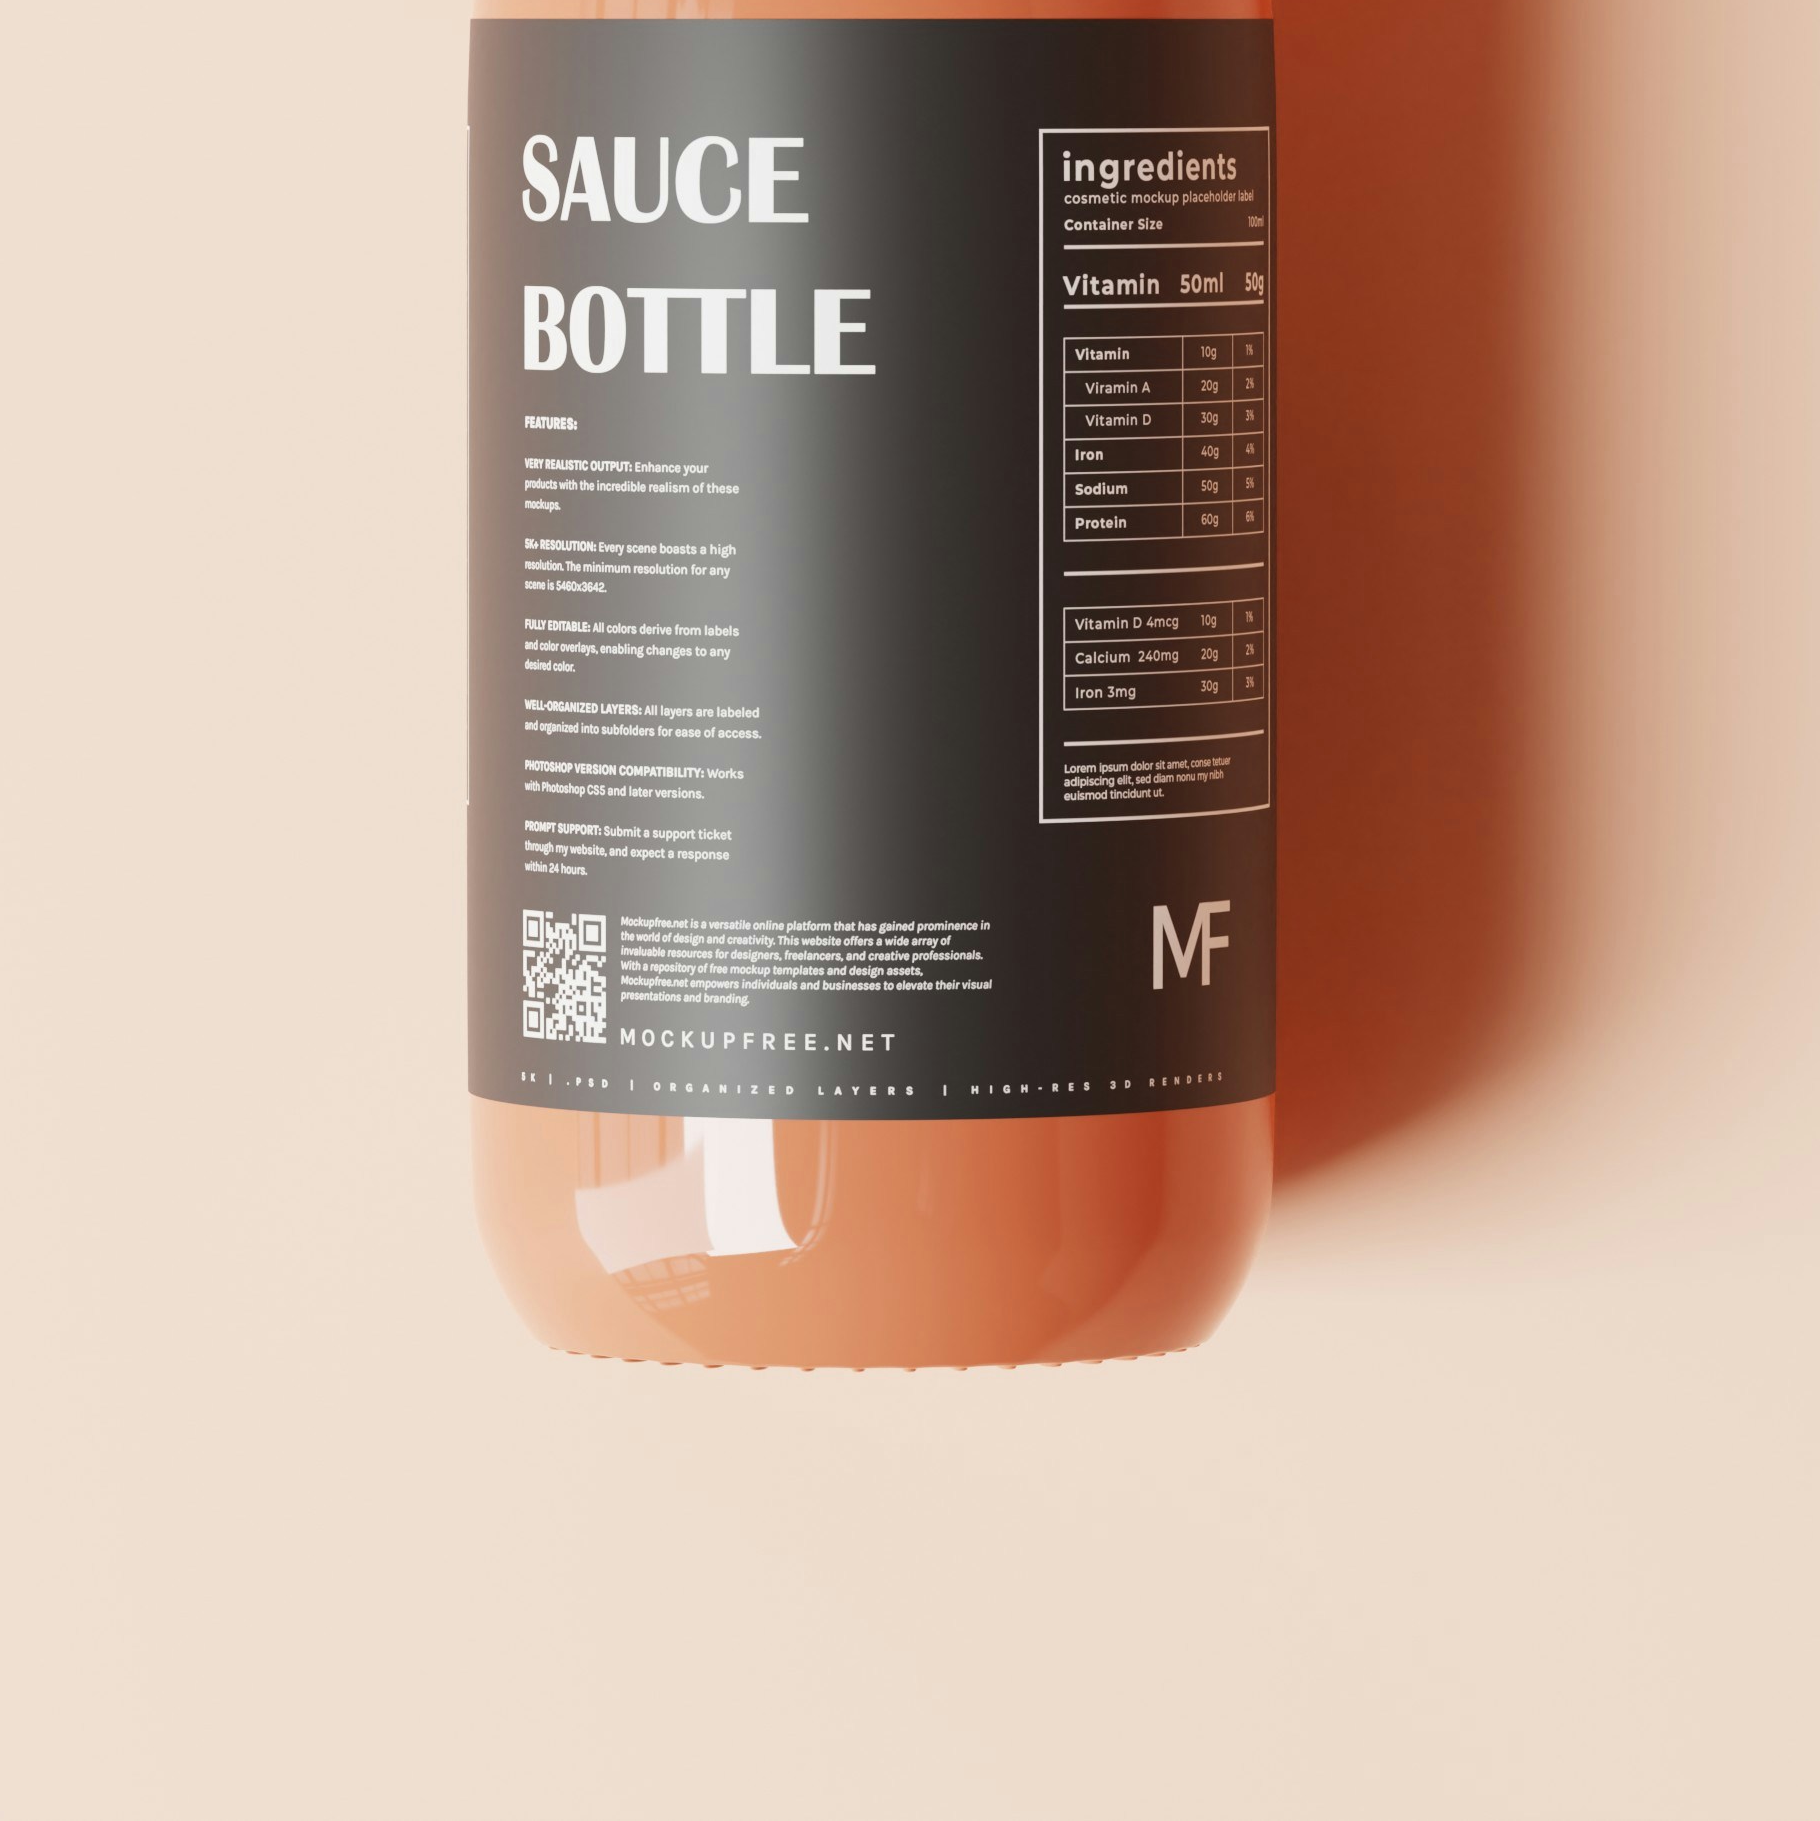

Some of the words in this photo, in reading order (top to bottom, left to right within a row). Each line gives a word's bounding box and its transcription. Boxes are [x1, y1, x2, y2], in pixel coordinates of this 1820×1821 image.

[1062, 149, 1237, 190] ingredients
[522, 134, 809, 224] SAUCE
[1064, 191, 1127, 205] cosmetic
[1131, 191, 1180, 206] mockup
[1182, 190, 1236, 206] placeholder
[1238, 189, 1254, 202] label
[1064, 217, 1134, 231] Container
[1137, 217, 1163, 231] Size
[1062, 272, 1160, 296] Vitamin
[1180, 271, 1224, 294] 50ml
[1245, 271, 1264, 296] 50g
[524, 285, 876, 375] BOTTLE
[1074, 347, 1130, 361] Vitamin
[1200, 345, 1217, 361] 10g
[1085, 381, 1138, 395] Viramin
[1141, 381, 1151, 393] A
[1201, 379, 1219, 394] 20g
[524, 415, 578, 431] FEATURES:
[1085, 413, 1138, 427] Vitamin
[1142, 413, 1152, 426] D
[1200, 411, 1219, 426] 30g
[1075, 448, 1104, 461] Iron
[1200, 445, 1219, 460] 40g
[524, 457, 544, 469] VERY
[544, 458, 589, 471] REALISTIC
[590, 460, 633, 473] OUTPUT:
[634, 461, 682, 474] Enhance
[682, 464, 710, 477] your
[524, 477, 558, 491] products
[558, 479, 578, 491] with
[579, 479, 595, 491] the
[596, 479, 647, 493] incredible
[648, 481, 690, 494] realism
[692, 481, 705, 494] of
[706, 482, 740, 495] these
[1075, 481, 1128, 496] Sodium
[1201, 479, 1219, 494] 50g
[524, 498, 561, 513] mockups.
[1075, 515, 1127, 530] Protein
[1201, 513, 1219, 528] 60g
[524, 537, 540, 550] 5K+
[539, 538, 597, 552] RESOLUTION:
[598, 541, 625, 557] Every
[626, 544, 658, 554] scene
[659, 542, 698, 555] boasts
[699, 545, 707, 555] a
[709, 543, 737, 559] high
[524, 559, 565, 571] resolution.
[564, 560, 582, 573] The
[582, 561, 632, 574] minimum
[633, 563, 688, 575] resolution
[690, 563, 708, 576] for
[709, 566, 731, 579] any
[524, 580, 546, 591] scene
[547, 579, 555, 591] is
[556, 580, 608, 593] 5460x3642.
[524, 618, 547, 631] FULLY
[547, 619, 591, 633] EDITABLE:
[592, 621, 605, 633] All
[606, 622, 638, 635] colors
[639, 623, 672, 636] derive
[674, 623, 702, 636] from
[704, 624, 740, 637] labels
[1074, 616, 1129, 631] Vitamin
[1133, 616, 1142, 629] D
[1146, 616, 1179, 630] 4mcg
[1200, 614, 1217, 629] 10g
[1075, 651, 1131, 665] Calcium
[1138, 649, 1179, 664] 240mg
[1201, 647, 1218, 662] 20g
[524, 658, 552, 671] desired
[552, 660, 576, 673] color.
[1075, 687, 1103, 699] Iron
[1107, 685, 1136, 701] 3mg
[1200, 679, 1219, 694] 30g
[524, 698, 599, 714] WELL-ORGANIZED
[600, 703, 642, 716] LAYERS:
[644, 704, 658, 716] All
[660, 704, 694, 720] layers
[695, 708, 714, 718] are
[716, 706, 760, 719] labeled
[524, 719, 539, 731] and
[539, 721, 579, 735] organized
[580, 722, 600, 735] into
[601, 723, 656, 737] subfolders
[657, 725, 674, 737] for
[674, 728, 702, 738] ease
[703, 726, 716, 739] of
[717, 729, 762, 739] access.
[524, 759, 574, 774] PHOTOSHOP
[574, 762, 617, 776] VERSION
[618, 764, 705, 779] COMPATIBILITY:
[706, 767, 744, 780] Works
[1064, 764, 1097, 774] Lorem
[1099, 762, 1129, 775] ipsum
[1130, 760, 1154, 772] dolor
[1155, 759, 1166, 771] sit
[1166, 759, 1190, 770] amet,
[524, 779, 541, 792] with
[541, 781, 586, 798] Photoshop
[586, 784, 606, 796] CS5
[607, 785, 627, 797] and
[628, 785, 654, 798] later
[654, 787, 705, 800] versions.
[1063, 789, 1108, 801] euismod
[1109, 788, 1152, 800] tincidunt
[1153, 787, 1165, 798] ut.
[524, 819, 557, 833] PROMPT
[557, 822, 602, 836] SUPPORT:
[603, 825, 642, 838] Submit
[643, 829, 650, 839] a
[652, 829, 696, 842] support
[697, 828, 732, 841] ticket
[524, 860, 548, 873] within
[548, 862, 560, 874] 24
[560, 862, 588, 876] hours.
[620, 915, 689, 930] Mockupfree.net
[690, 918, 699, 929] is
[700, 920, 707, 930] a
[708, 919, 752, 931] versatile
[752, 919, 785, 931] online
[786, 920, 832, 934] platform
[833, 921, 856, 932] that
[857, 921, 878, 932] has
[878, 920, 915, 935] gained
[916, 920, 979, 934] prominence
[980, 919, 991, 931] in
[620, 975, 689, 989] Mockupfree.net
[689, 979, 740, 991] empowers
[741, 978, 798, 991] individuals
[799, 979, 820, 991] and
[822, 979, 882, 991] businesses
[883, 980, 895, 991] to
[895, 979, 934, 991] elevate
[935, 979, 961, 991] their
[961, 979, 993, 990] visual
[620, 991, 682, 1003] presentations
[682, 992, 702, 1003] and
[620, 1027, 896, 1051] MOCKUPFREE.NET
[1110, 1079, 1132, 1090] 3D
